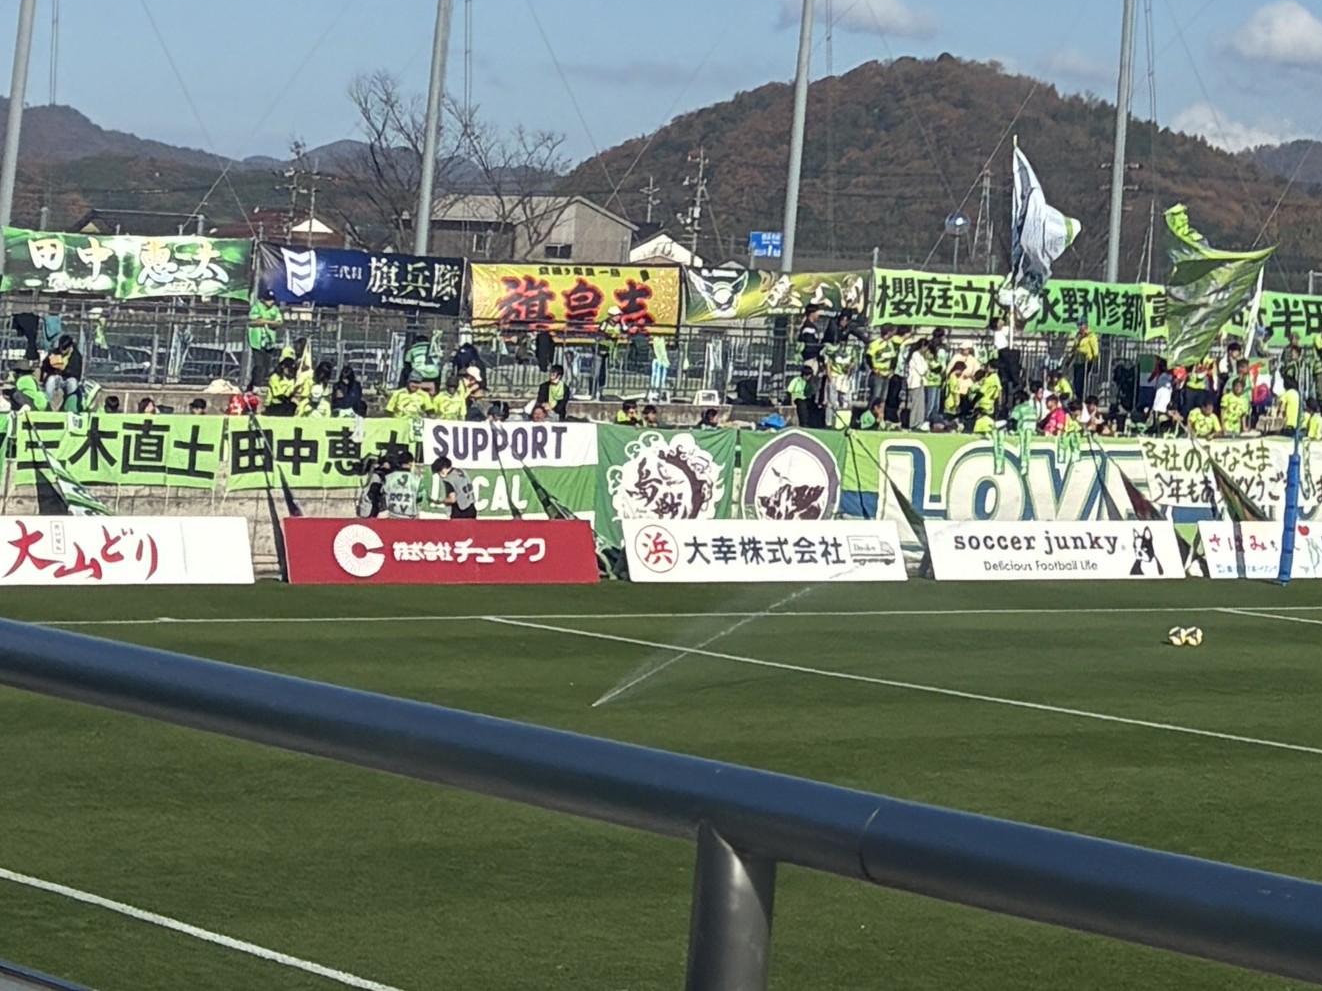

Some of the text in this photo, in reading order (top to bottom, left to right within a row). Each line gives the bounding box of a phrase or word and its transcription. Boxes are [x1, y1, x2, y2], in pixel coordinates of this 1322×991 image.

[432, 425, 567, 461] SUPPORT
[429, 473, 528, 511] LCAL
[2, 520, 158, 580] 大山どり
[684, 536, 847, 565] 大幸株式会社
[954, 531, 1118, 555] soccer junky
[1036, 560, 1079, 572] Football
